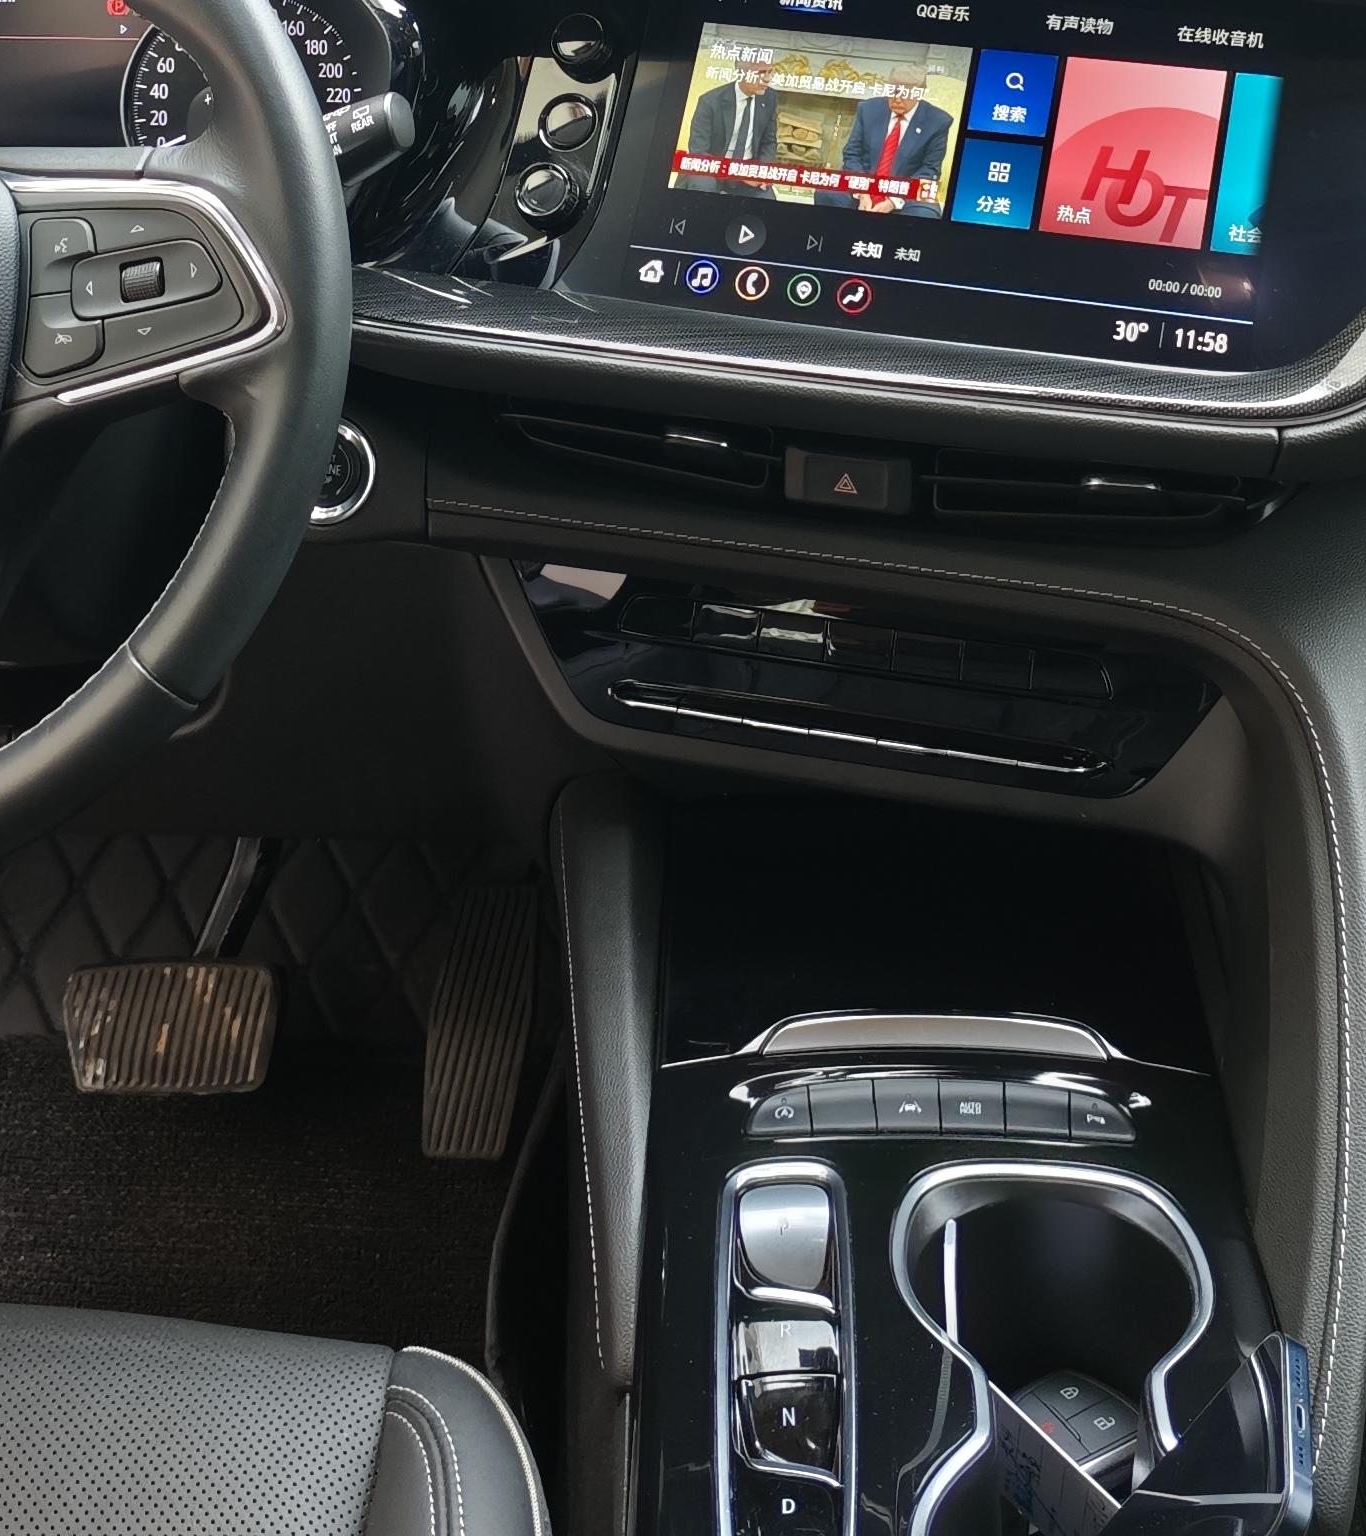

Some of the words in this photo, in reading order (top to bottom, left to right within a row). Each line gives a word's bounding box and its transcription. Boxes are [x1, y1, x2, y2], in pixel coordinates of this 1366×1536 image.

[916, 3, 970, 22] QQ音乐
[282, 20, 305, 36] 160
[1045, 13, 1114, 36] 有声读物
[1176, 25, 1265, 49] 在线收音机
[304, 39, 328, 55] 180
[709, 43, 774, 65] 热点新闻
[156, 57, 175, 74] 60
[318, 63, 343, 78] 200
[149, 83, 169, 100] 40
[326, 88, 351, 103] 220
[149, 110, 168, 126] 20
[991, 104, 1027, 124] 搜索
[350, 115, 375, 134] REAR
[1080, 145, 1209, 243] HOT
[976, 195, 1011, 215] 分类
[1056, 204, 1092, 225] 热点
[1228, 223, 1262, 243] 社会
[851, 240, 883, 259] 未知
[894, 247, 921, 262] 未知
[1148, 278, 1180, 293] 00:00
[1190, 283, 1222, 298] 00:00
[1112, 320, 1149, 342] 30°
[1175, 327, 1228, 354] 11:58
[780, 1322, 791, 1337] R
[782, 1407, 796, 1426] N
[781, 1498, 796, 1515] D
